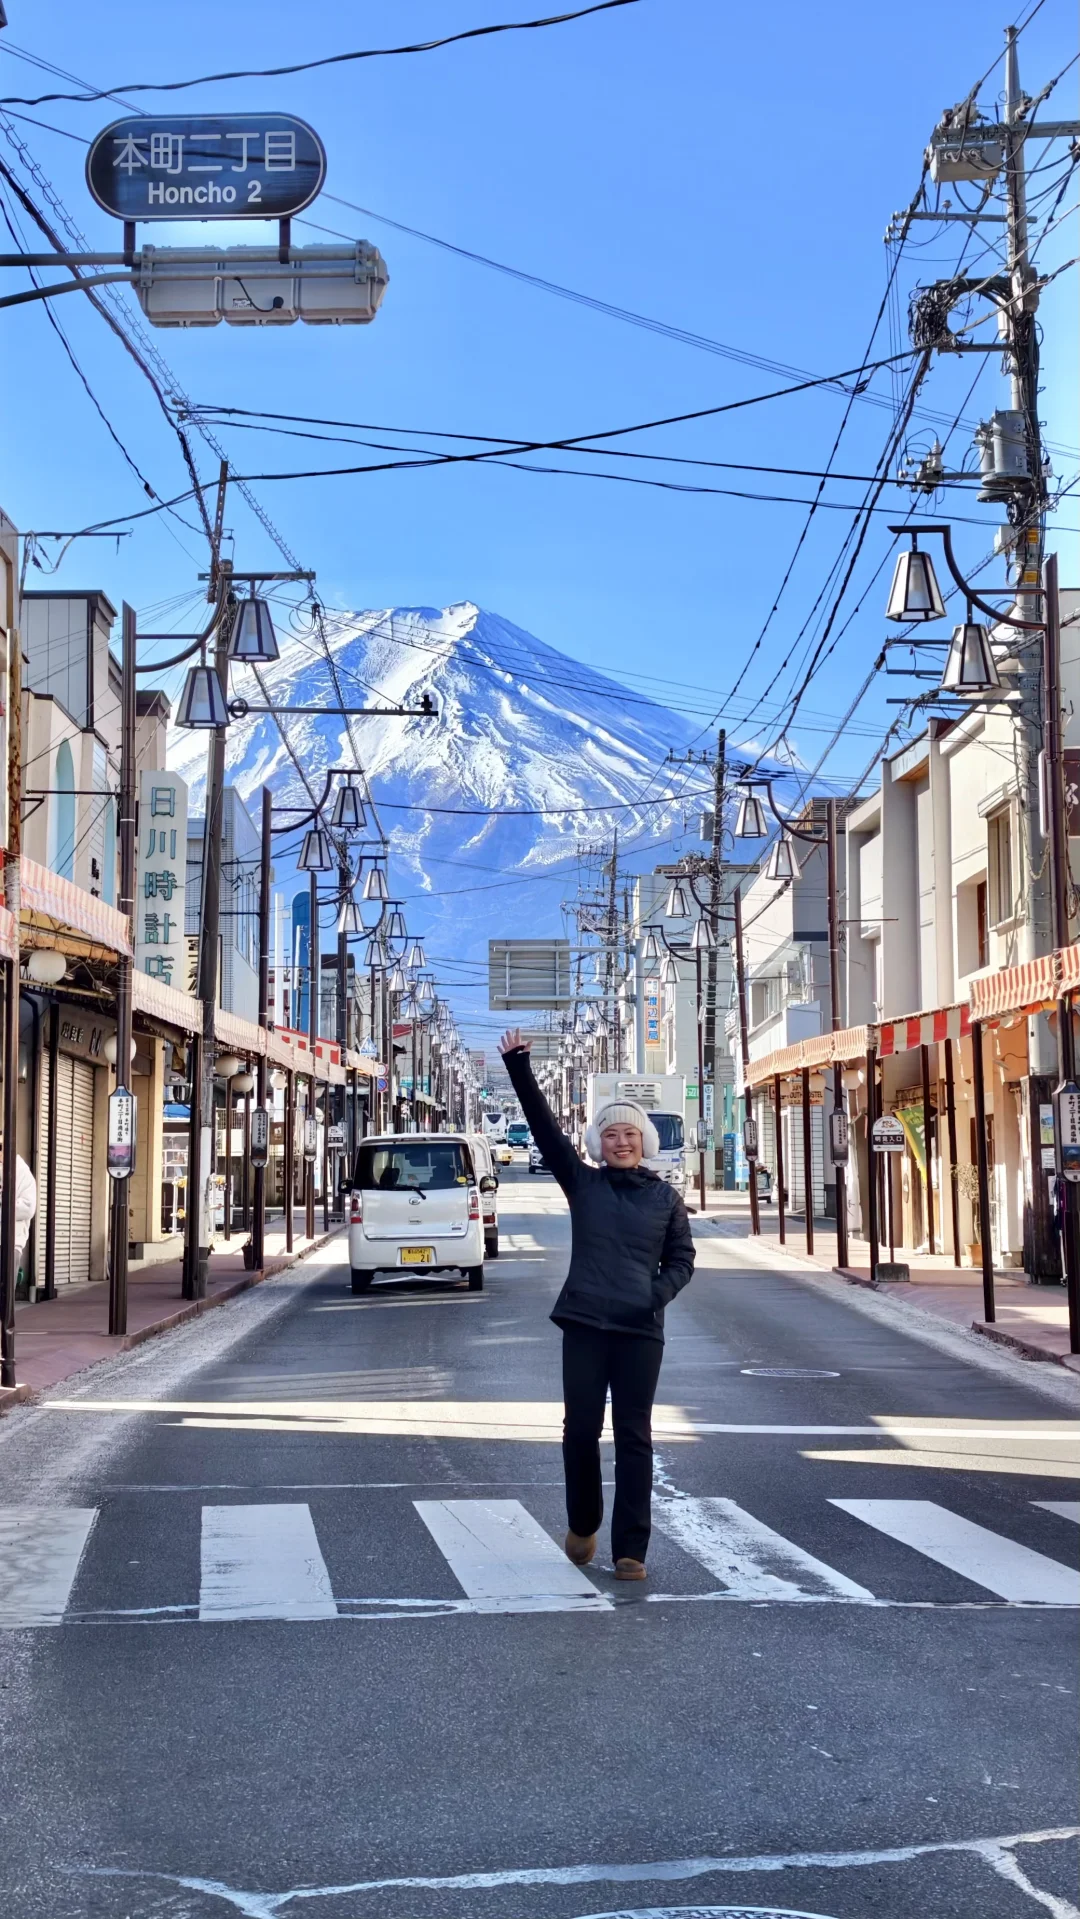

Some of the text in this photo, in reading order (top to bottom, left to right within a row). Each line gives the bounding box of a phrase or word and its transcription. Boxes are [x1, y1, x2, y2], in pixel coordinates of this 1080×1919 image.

[113, 131, 296, 176] 本町二丁目
[148, 180, 262, 204] Honcho 2
[144, 787, 178, 986] 日川時計店
